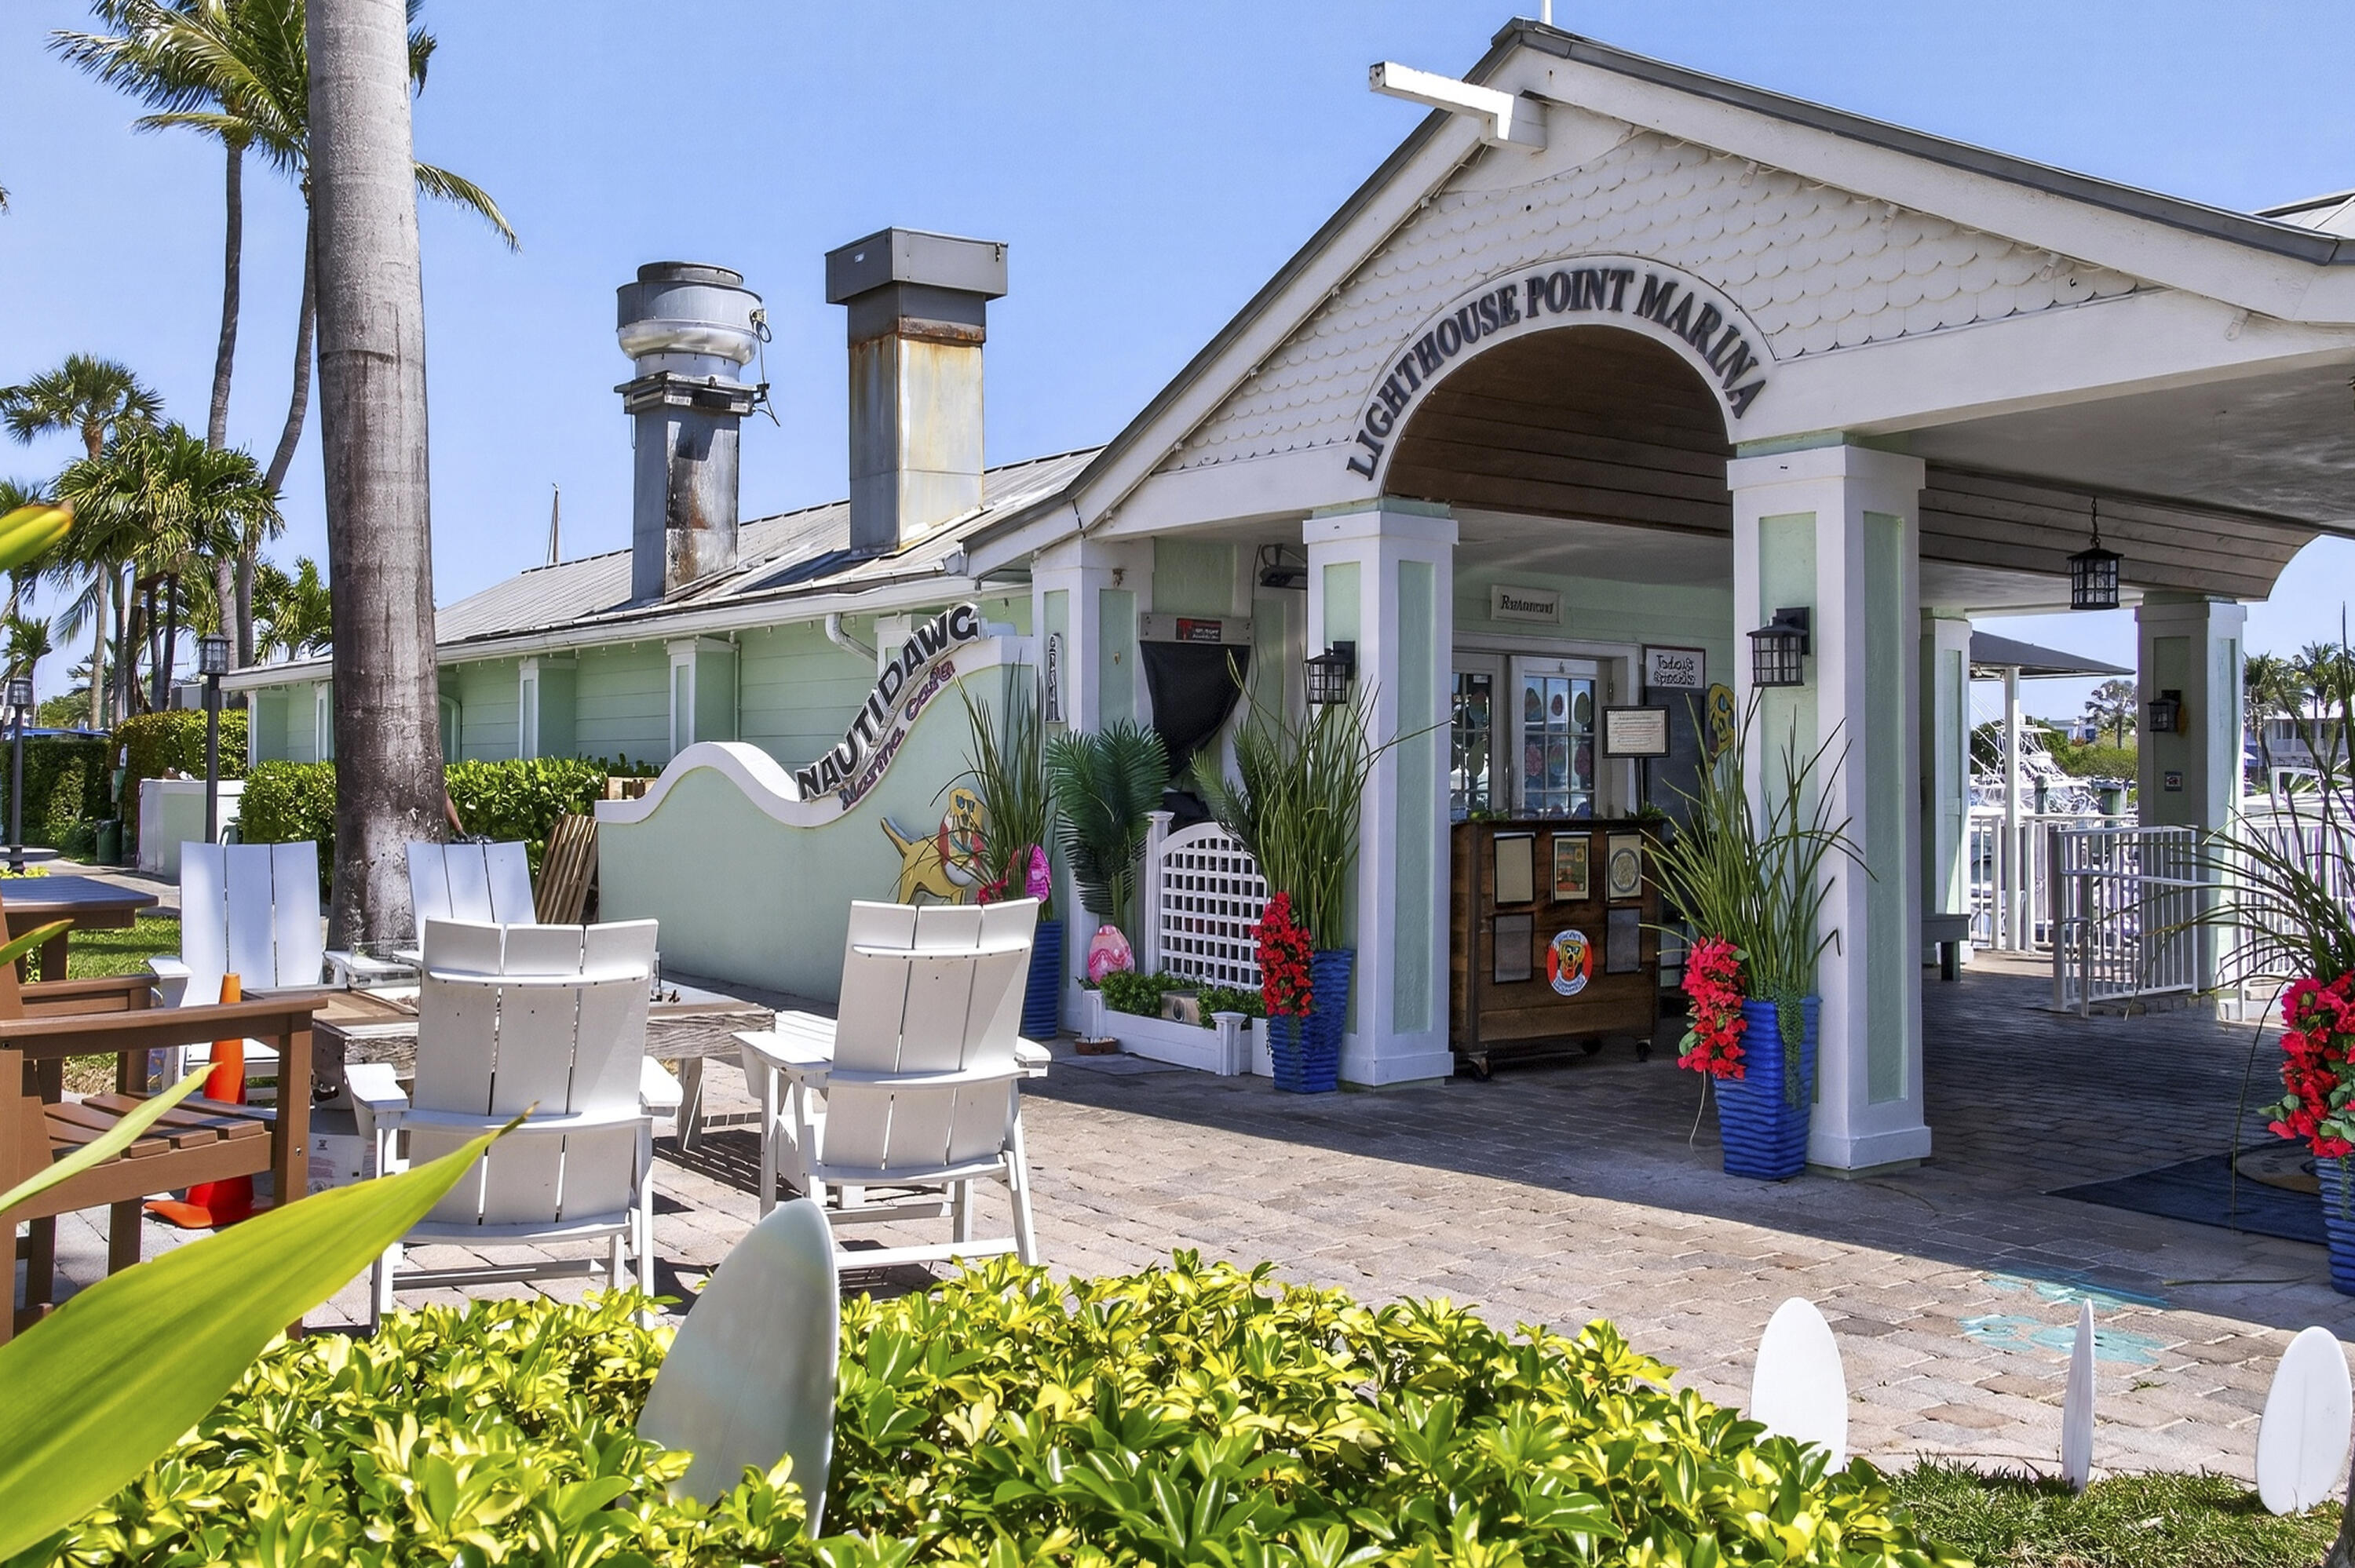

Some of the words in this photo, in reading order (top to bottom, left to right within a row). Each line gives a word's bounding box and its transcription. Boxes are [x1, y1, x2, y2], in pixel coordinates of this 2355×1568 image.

[1346, 283, 1521, 481] LIGHTHOUSE
[1524, 268, 1635, 319] POINT
[1633, 274, 1766, 419] MARINA
